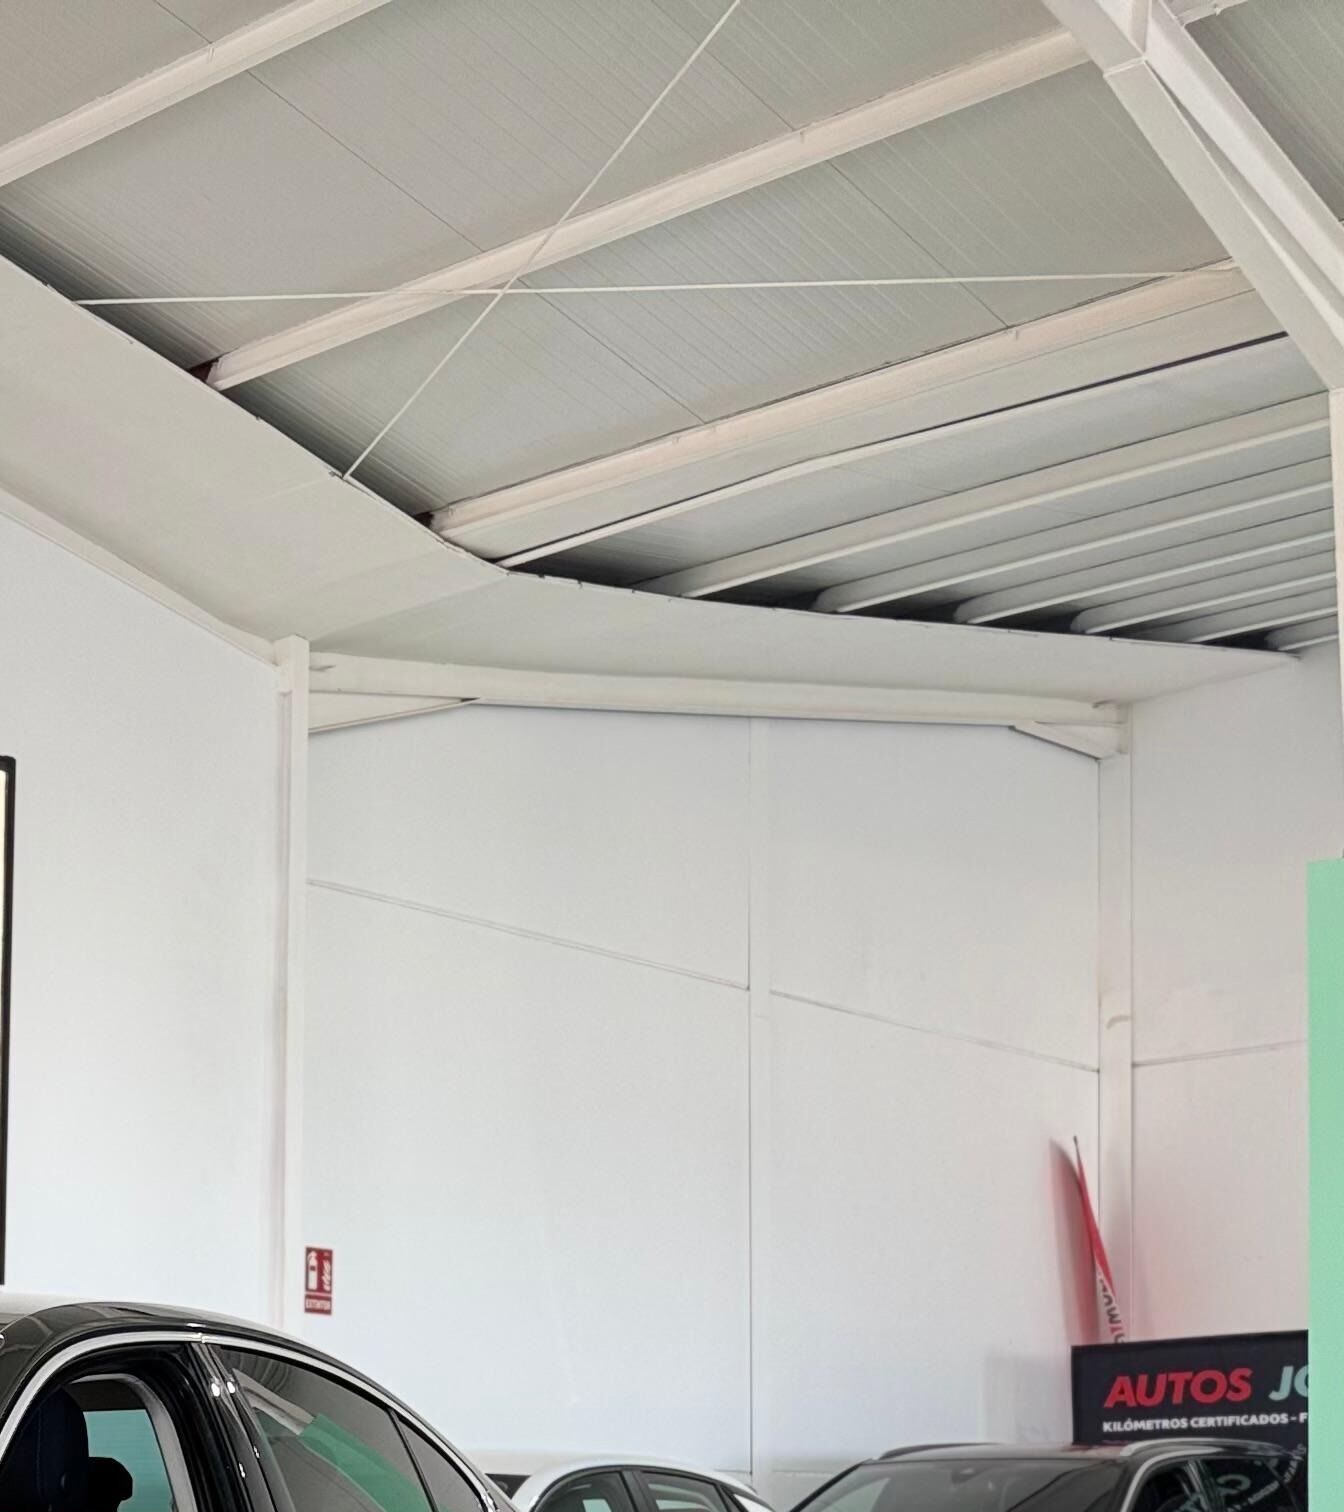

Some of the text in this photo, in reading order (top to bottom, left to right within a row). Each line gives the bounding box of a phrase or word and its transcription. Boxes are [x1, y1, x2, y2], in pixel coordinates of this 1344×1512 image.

[1103, 1367, 1253, 1409] AUTOS
[1102, 1417, 1189, 1433] KILÓMETROS
[1190, 1412, 1289, 1429] CERTIFICADOS
